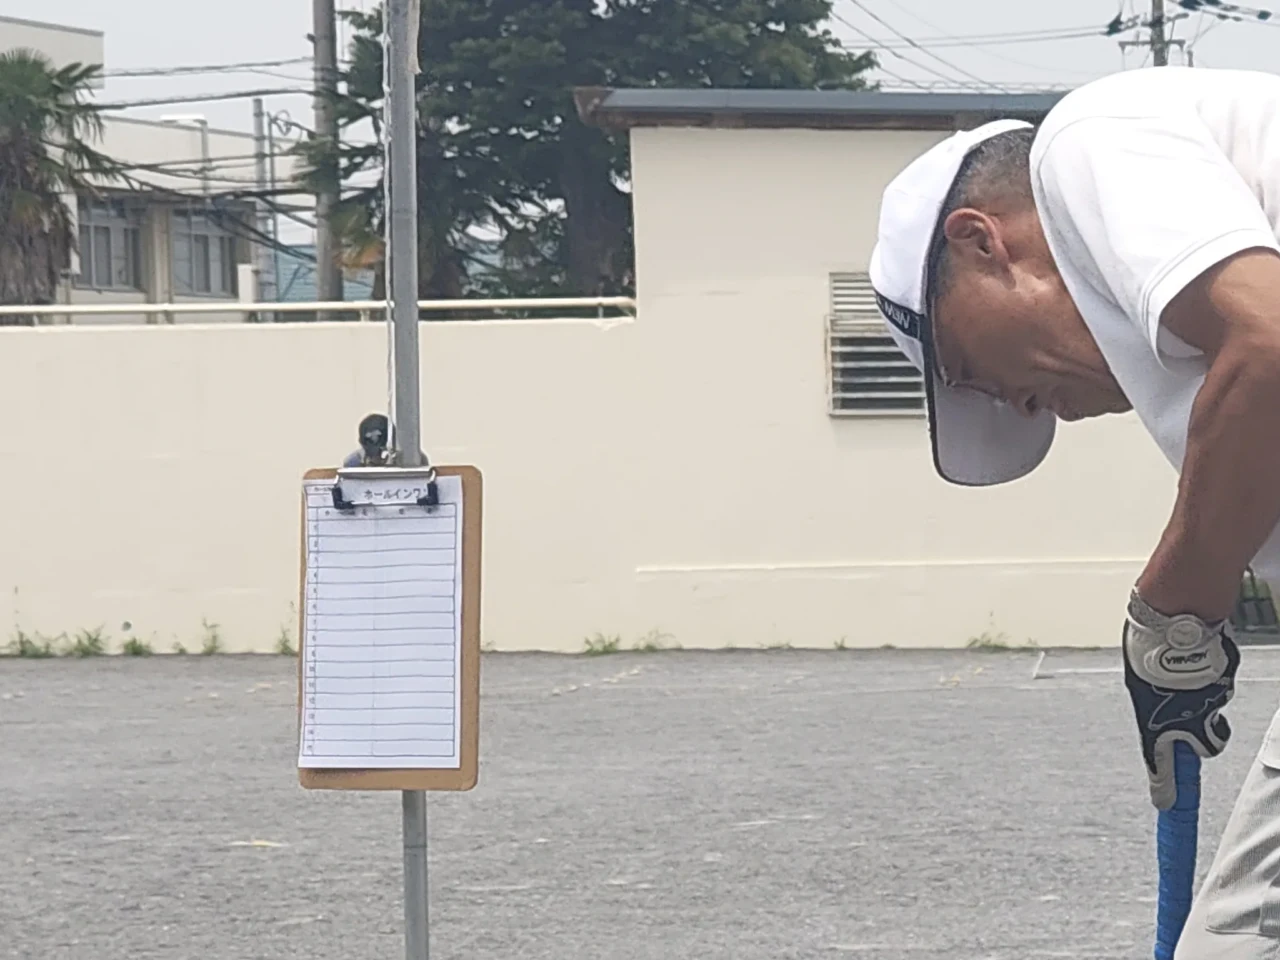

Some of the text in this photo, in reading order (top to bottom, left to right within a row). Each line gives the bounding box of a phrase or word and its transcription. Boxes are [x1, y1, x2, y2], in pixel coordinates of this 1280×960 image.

[364, 487, 427, 501] ホールインワ
